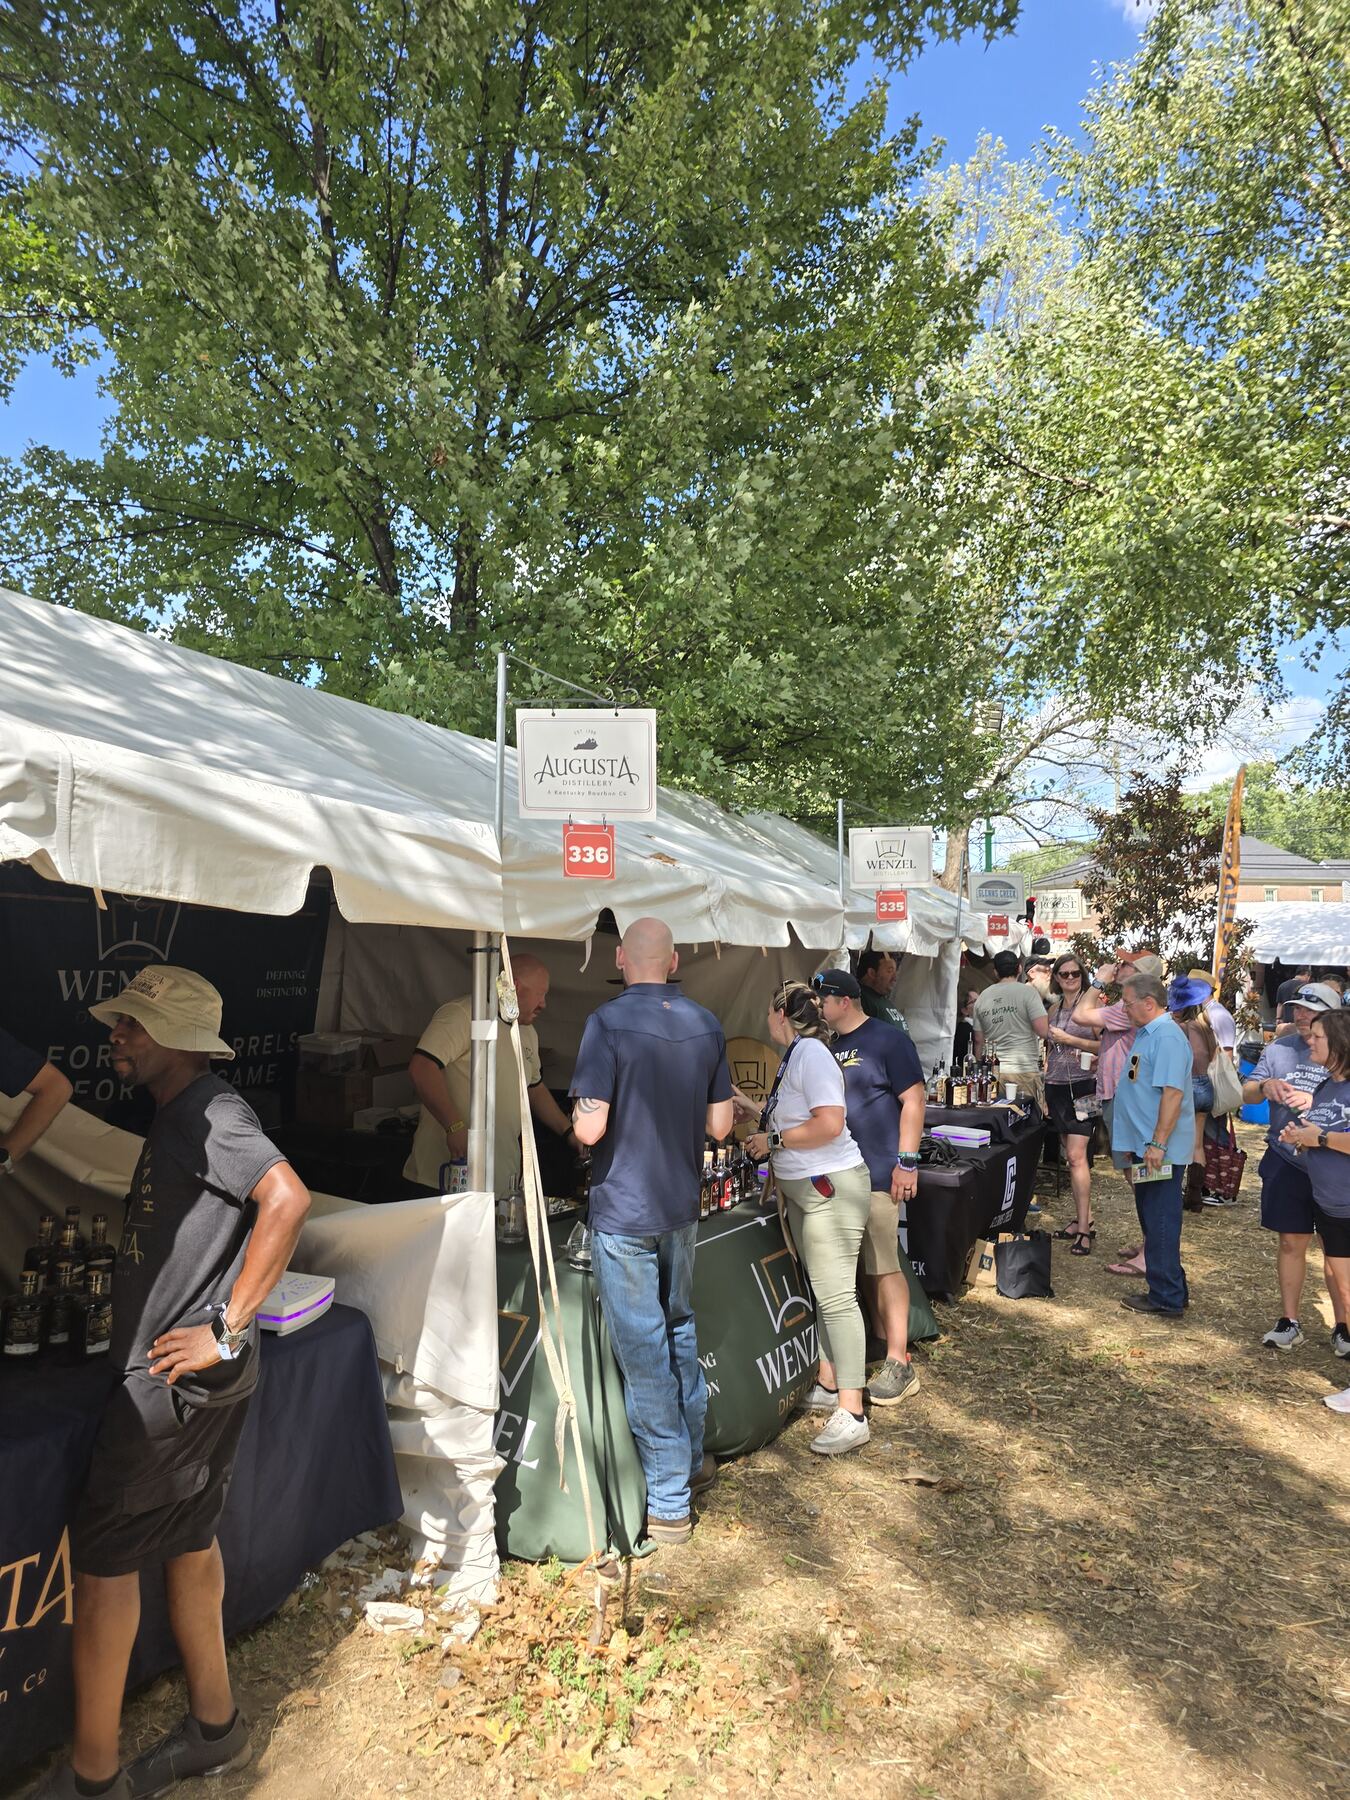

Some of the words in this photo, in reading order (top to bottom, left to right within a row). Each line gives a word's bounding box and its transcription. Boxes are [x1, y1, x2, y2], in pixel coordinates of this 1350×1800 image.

[533, 754, 640, 786] AUGUSTA
[562, 779, 613, 787] DISTILLERY
[568, 845, 609, 864] 336
[866, 859, 917, 870] WENZEL
[879, 901, 905, 912] 335
[990, 922, 1007, 931] 334
[57, 969, 139, 1001] WEN
[755, 1321, 820, 1395] WENZ
